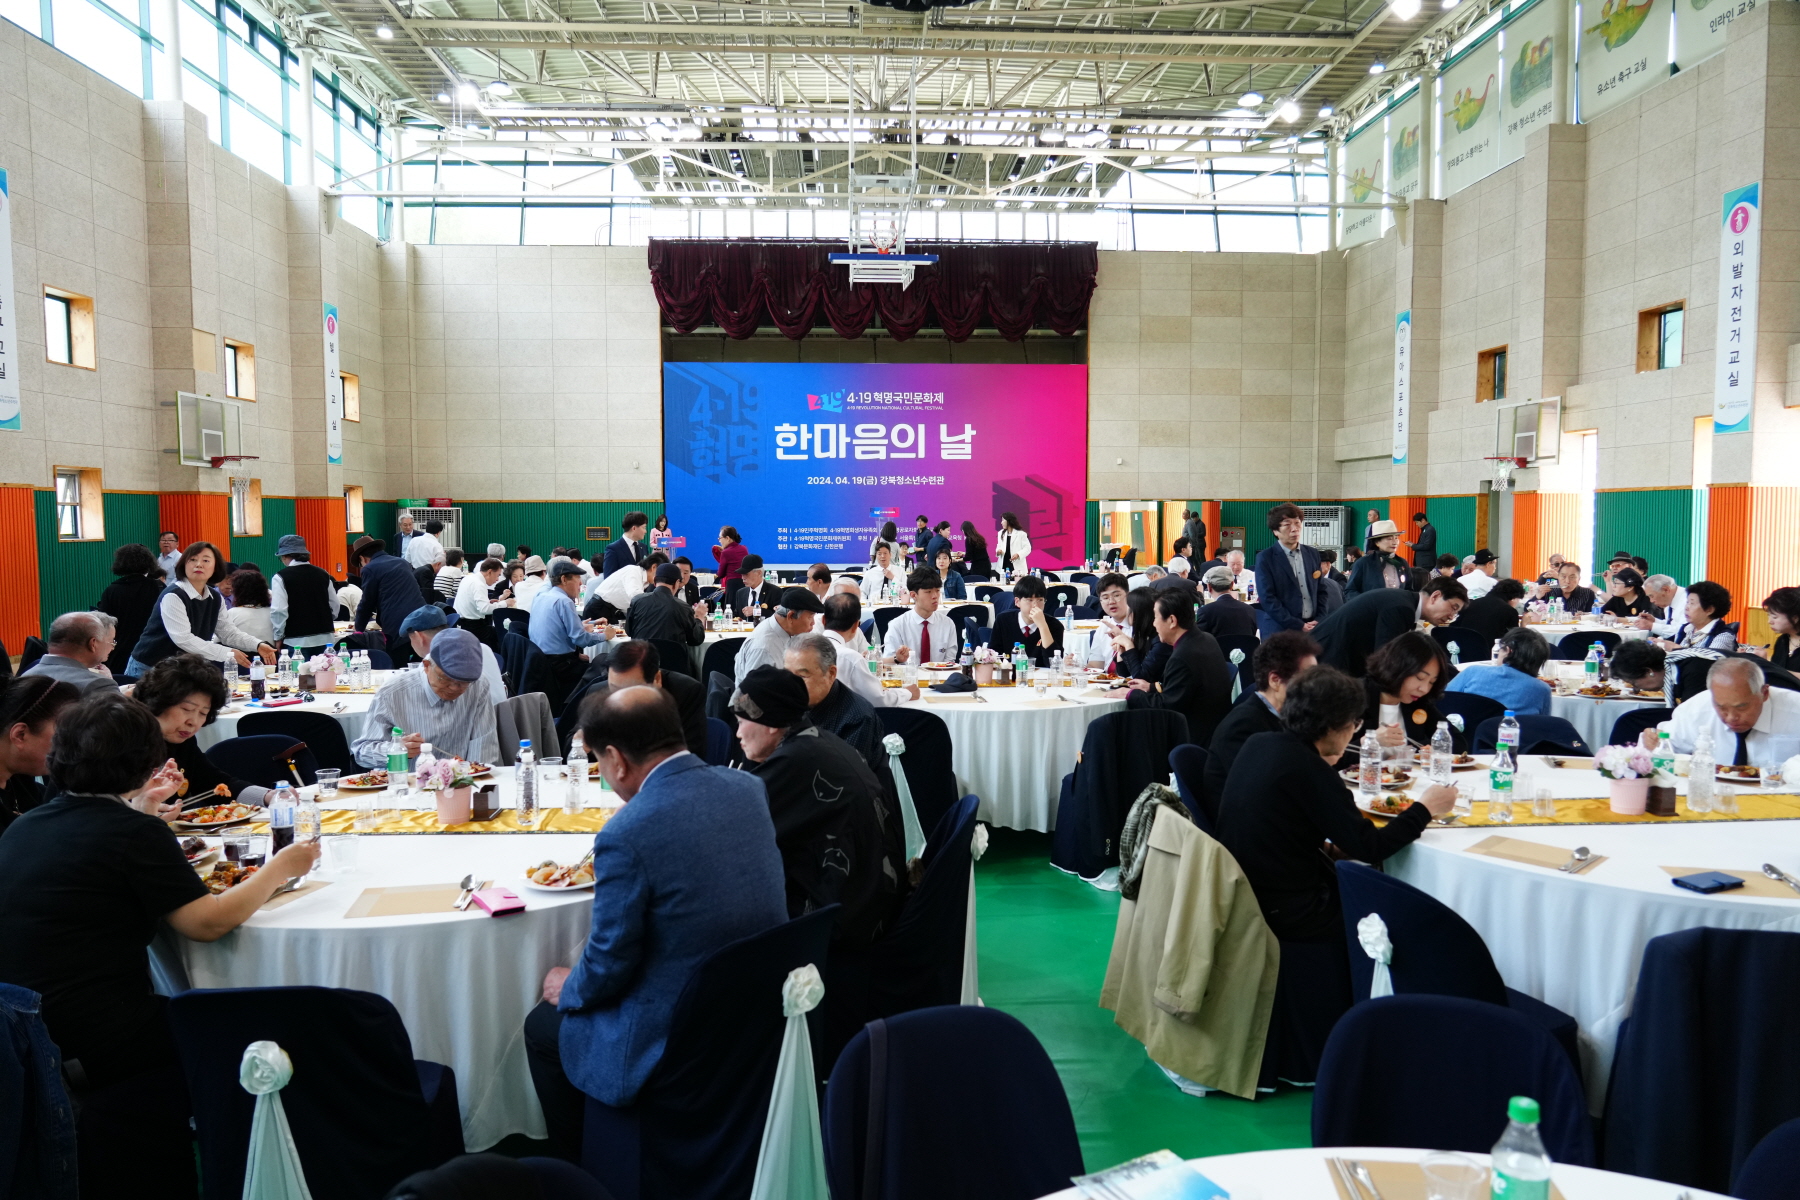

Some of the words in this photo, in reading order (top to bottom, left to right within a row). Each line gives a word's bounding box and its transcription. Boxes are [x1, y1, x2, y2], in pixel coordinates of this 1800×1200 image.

[1709, 8, 1735, 33] 인라인
[1736, 0, 1756, 16] 교실
[1597, 76, 1617, 95] 유소년
[1617, 68, 1632, 84] 축구
[1633, 57, 1648, 75] 교실
[1519, 110, 1536, 129] 청소년
[774, 423, 926, 461] 한마음의
[939, 423, 977, 460] 날
[807, 476, 834, 485] 2024.
[835, 476, 850, 485] 04.
[852, 475, 878, 486] 19(금)
[879, 475, 945, 486] 강북청소년수련관
